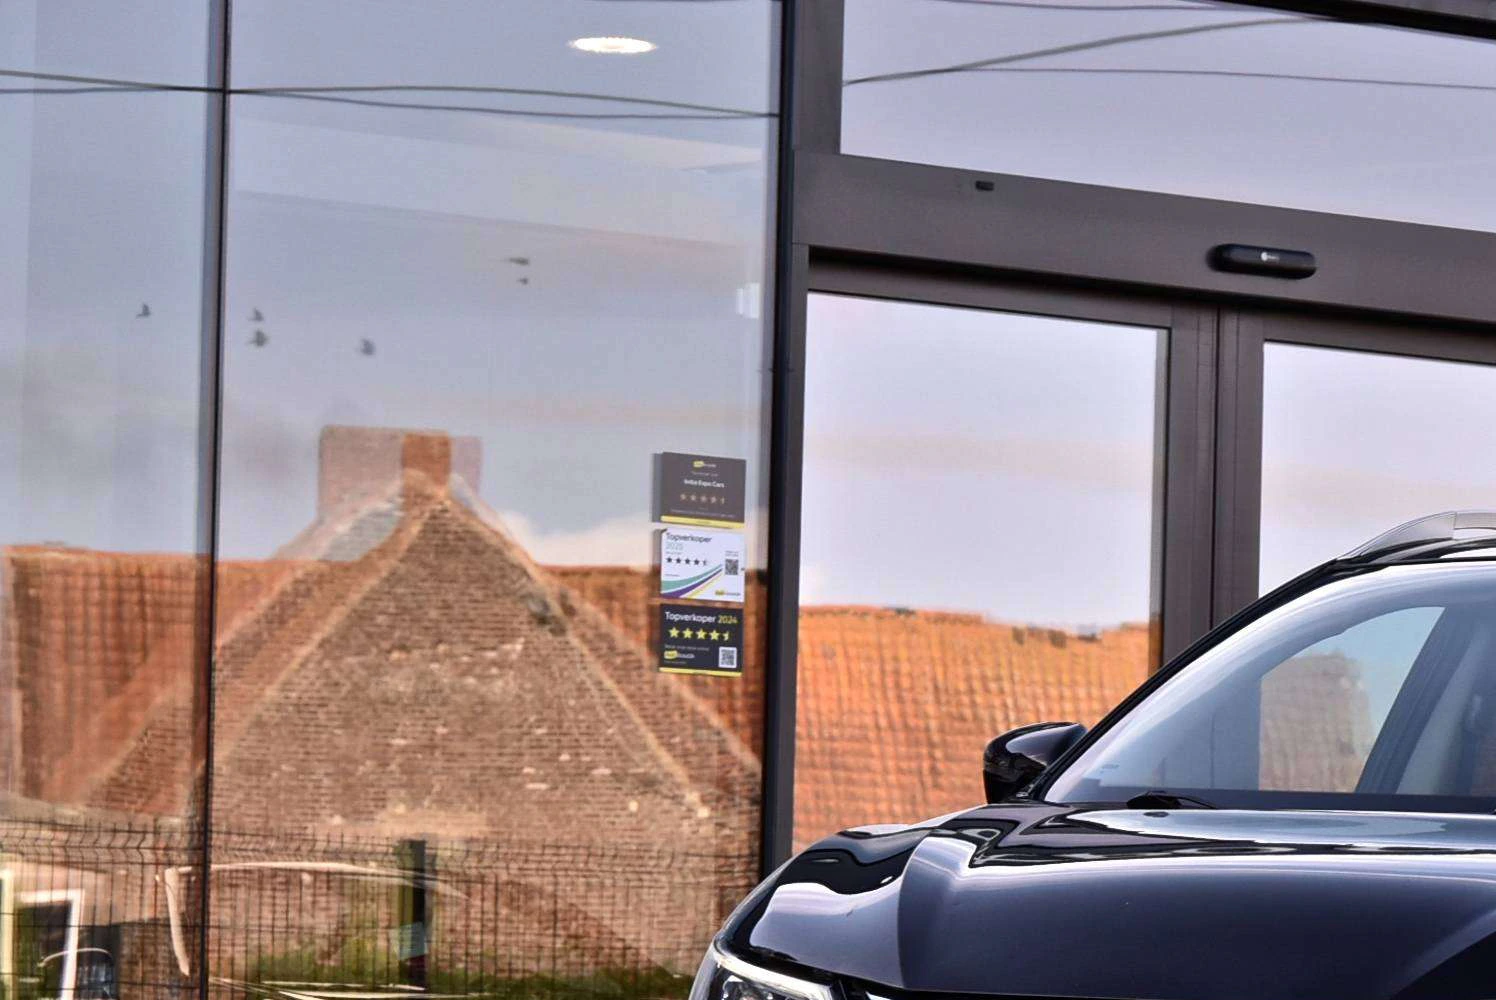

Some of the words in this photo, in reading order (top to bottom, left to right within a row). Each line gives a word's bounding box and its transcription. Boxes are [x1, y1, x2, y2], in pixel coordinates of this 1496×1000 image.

[666, 532, 712, 543] Topverkoper
[665, 611, 716, 624] Topverkoper
[718, 614, 738, 624] 2024
